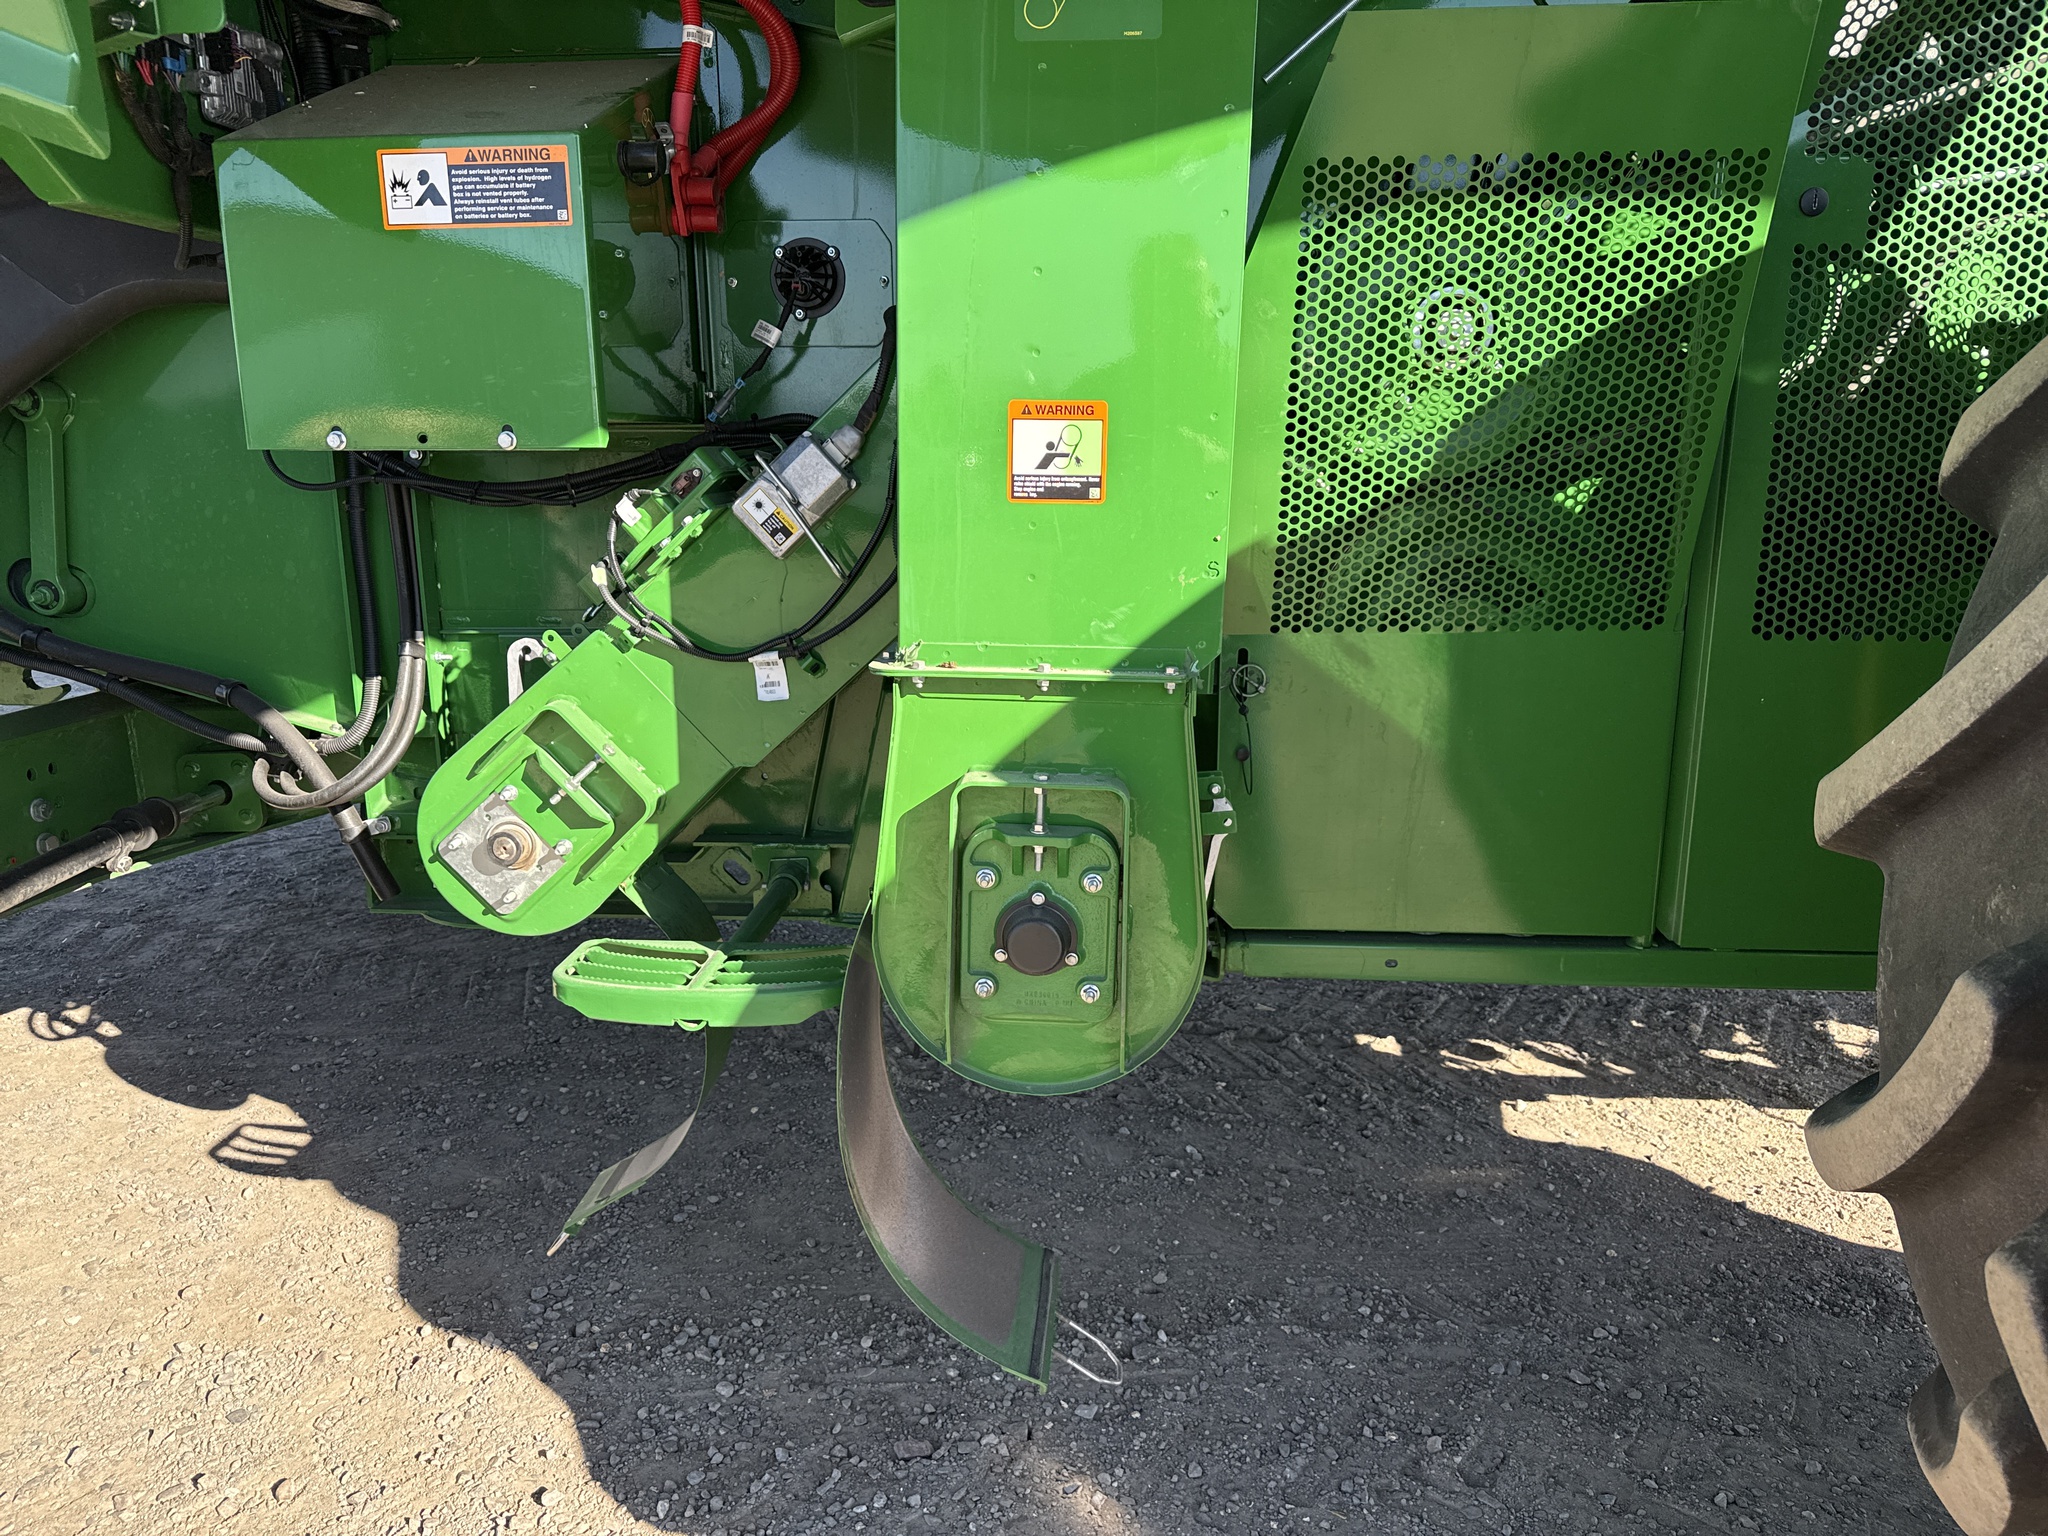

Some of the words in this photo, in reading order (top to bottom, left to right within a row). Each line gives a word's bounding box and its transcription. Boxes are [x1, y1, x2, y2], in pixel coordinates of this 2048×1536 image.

[478, 148, 550, 161] WARNING
[1035, 405, 1094, 415] WARNING
[779, 514, 795, 530] CAUTION
[1208, 561, 1219, 577] S
